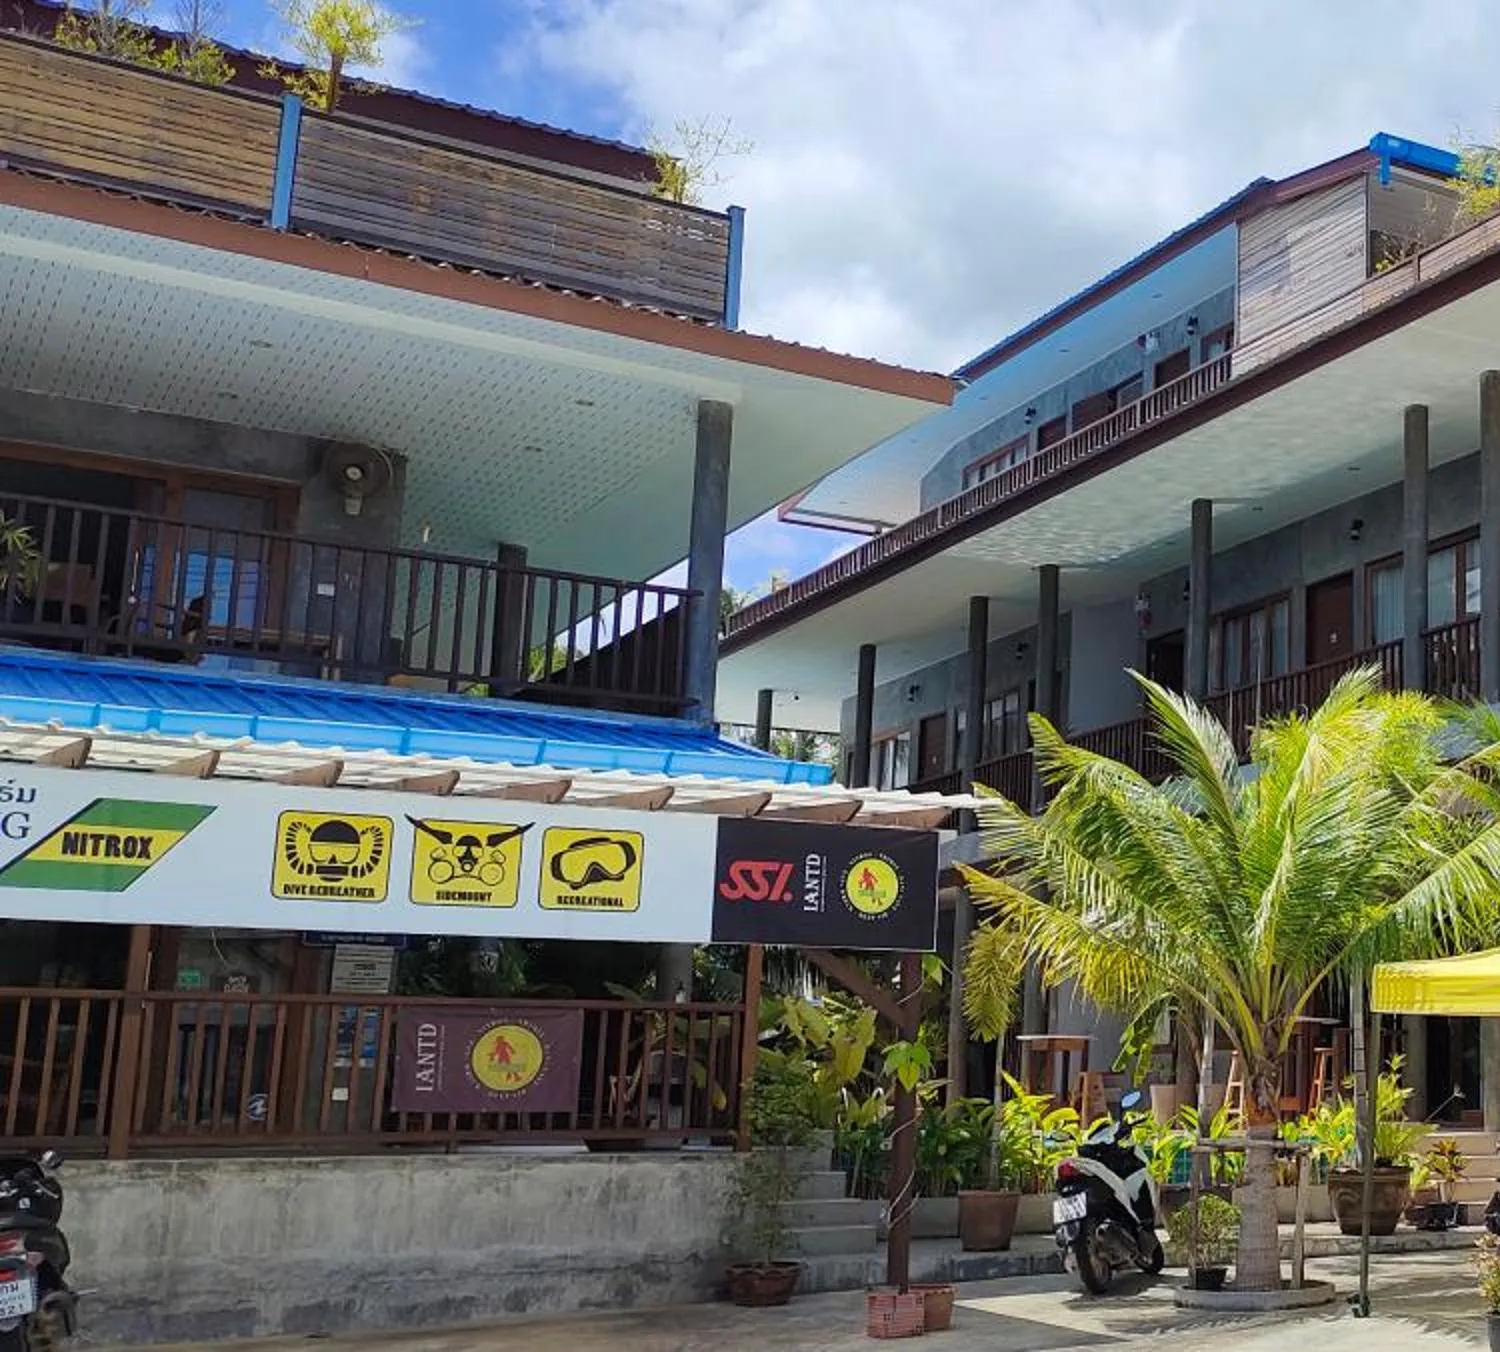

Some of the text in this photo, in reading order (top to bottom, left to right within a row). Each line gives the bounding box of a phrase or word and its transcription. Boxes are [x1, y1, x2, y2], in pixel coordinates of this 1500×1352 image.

[61, 831, 153, 859] NITROX
[283, 884, 375, 898] DIVE REBREATHER
[804, 853, 820, 912] IANTD
[436, 891, 492, 902] SIDEMOUNT
[557, 896, 624, 907] RECREATIONAL
[416, 1023, 437, 1092] IANTD
